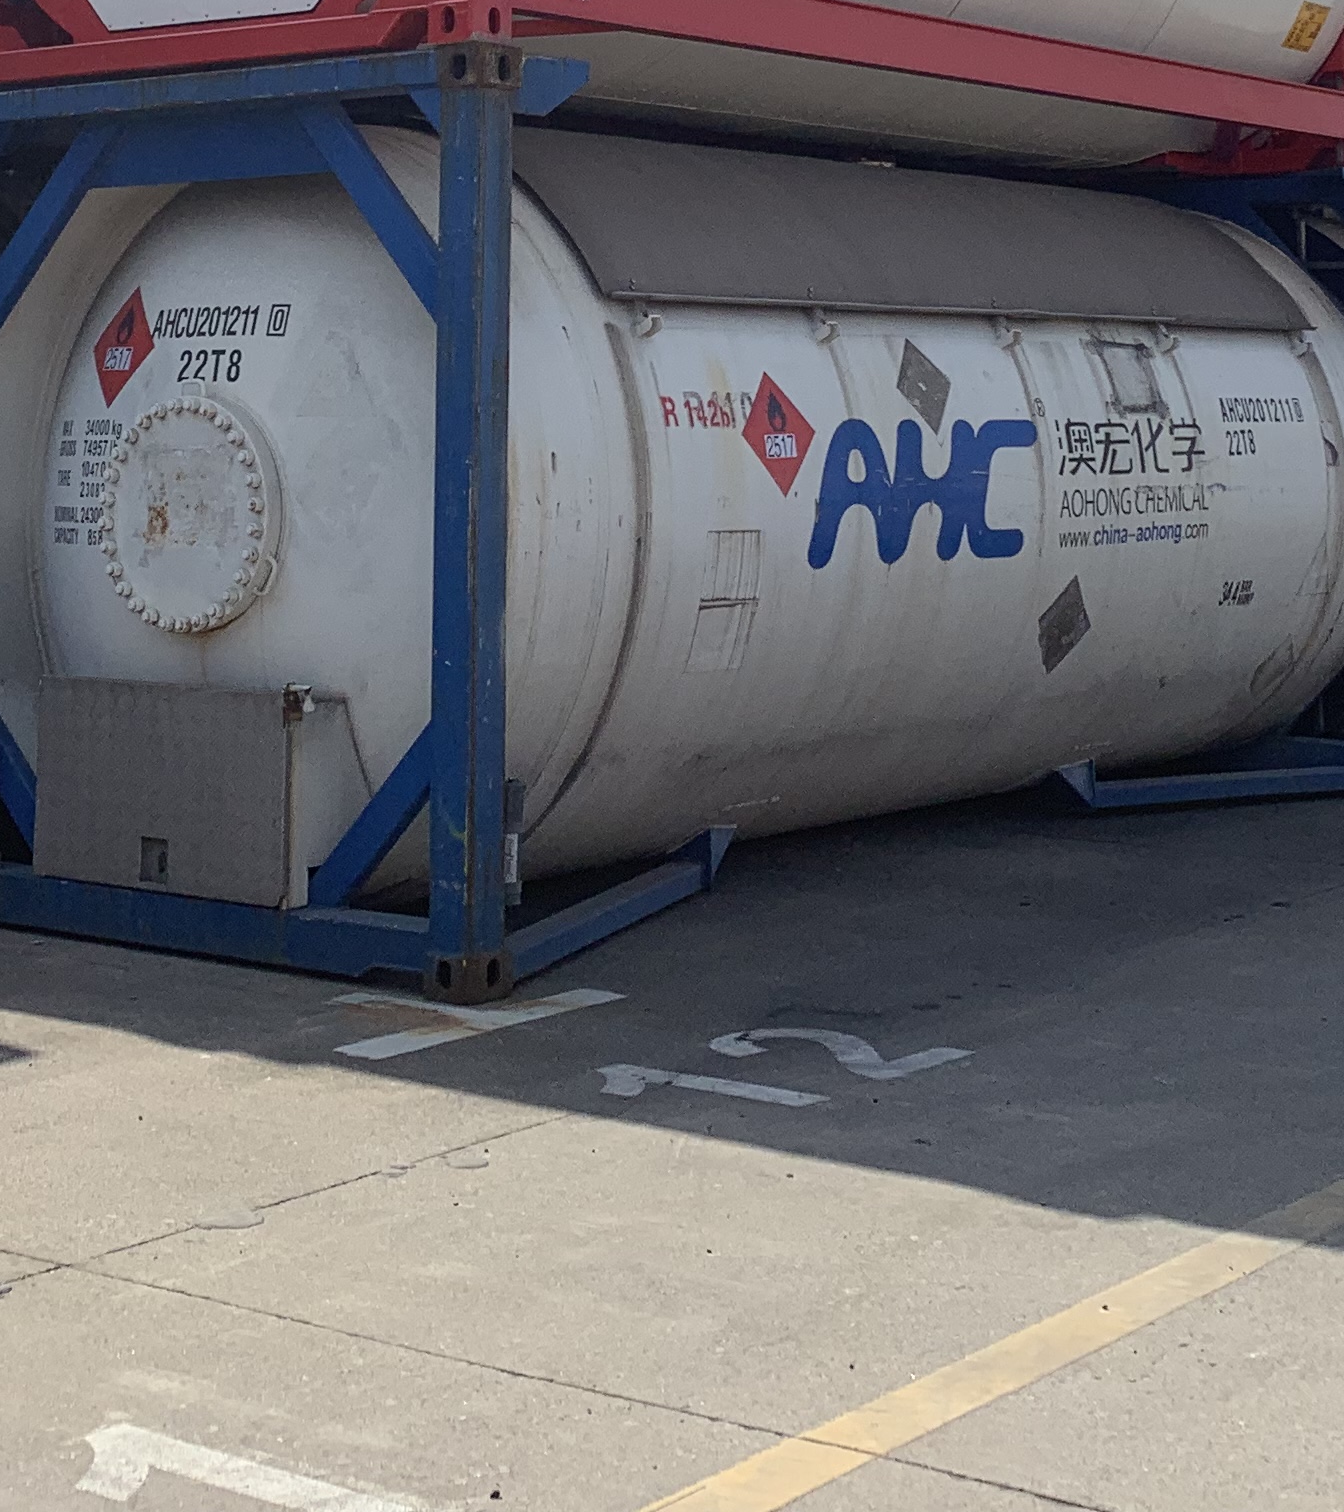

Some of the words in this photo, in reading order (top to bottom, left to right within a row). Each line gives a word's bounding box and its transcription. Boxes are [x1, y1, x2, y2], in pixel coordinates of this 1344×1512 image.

[151, 305, 260, 339] AHCU201211
[104, 348, 132, 370] 2517
[177, 349, 242, 382] 22T8
[659, 396, 679, 427] R
[1218, 397, 1293, 423] AHCU201211
[111, 420, 123, 441] kg
[1226, 430, 1256, 457] 22T8
[766, 435, 795, 458] 2517
[1055, 417, 1206, 476] 澳宏化学
[1060, 487, 1132, 518] AOHONG
[1135, 486, 1208, 514] CHEMICAL
[594, 1028, 976, 1107] 12
